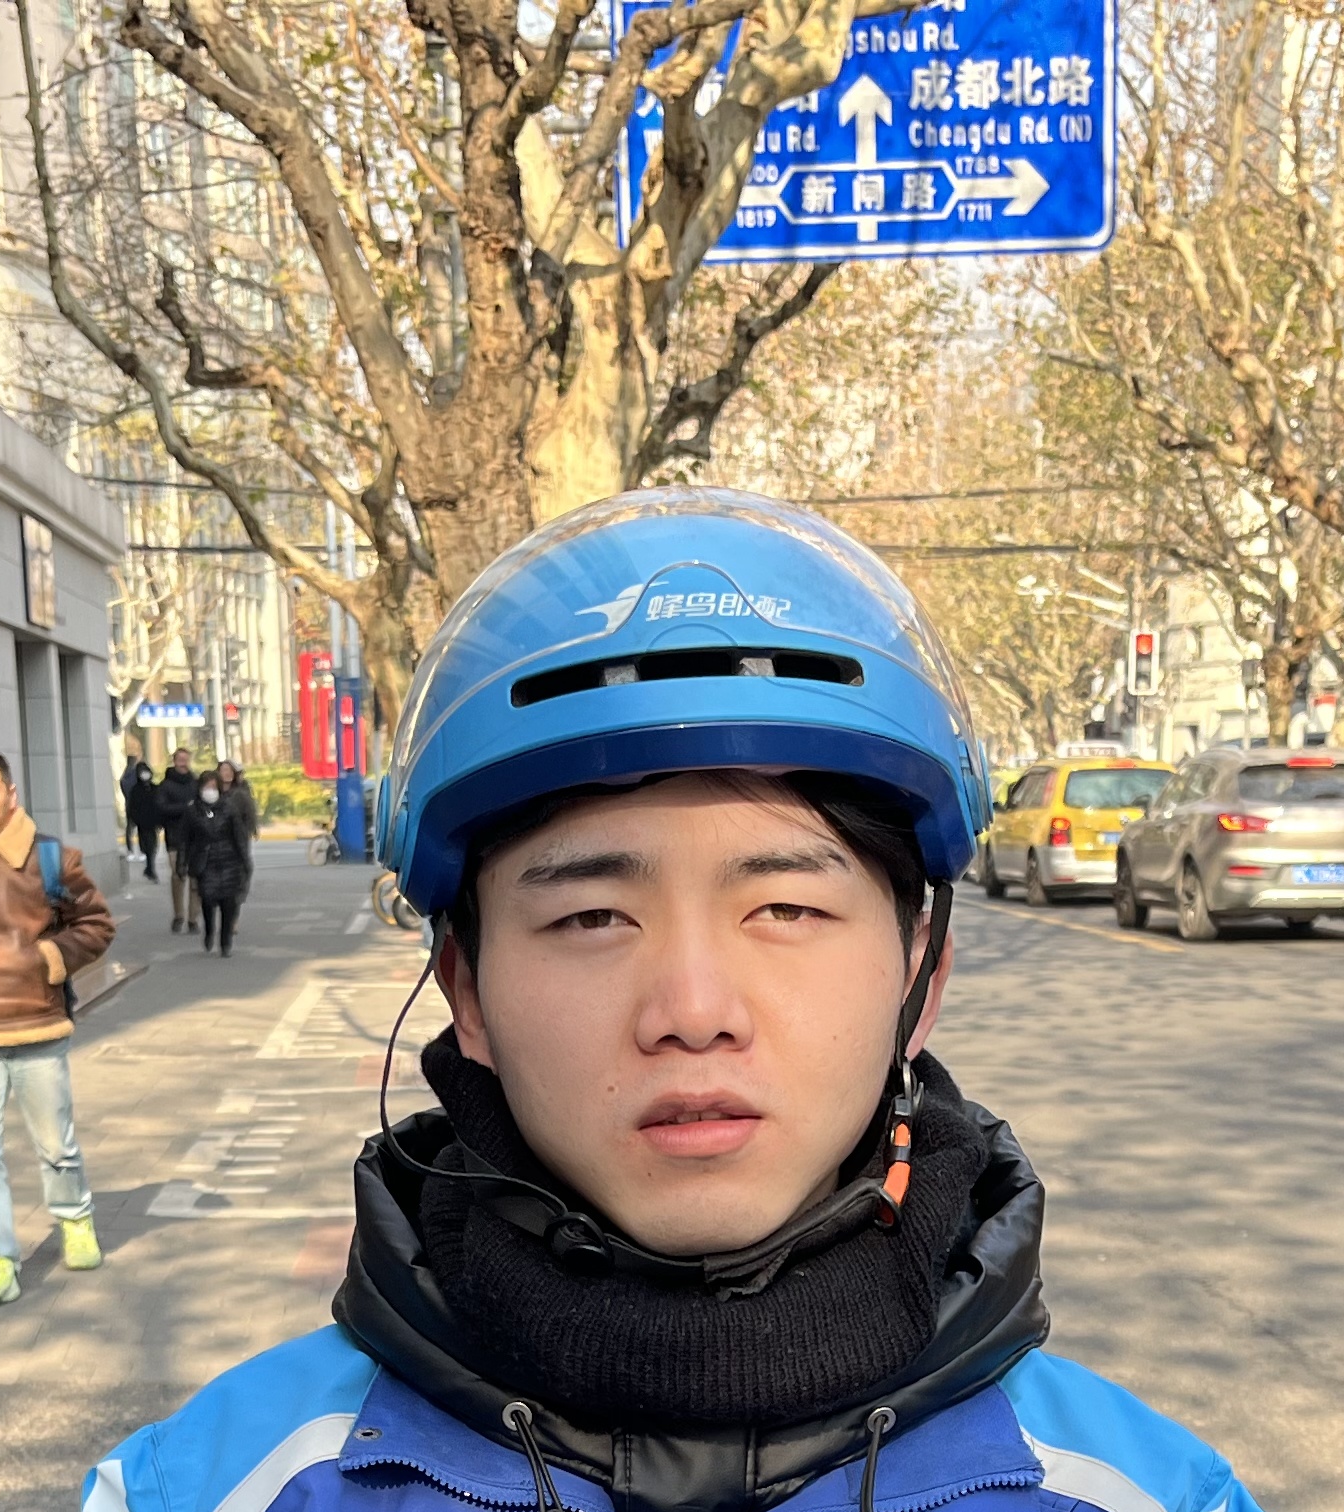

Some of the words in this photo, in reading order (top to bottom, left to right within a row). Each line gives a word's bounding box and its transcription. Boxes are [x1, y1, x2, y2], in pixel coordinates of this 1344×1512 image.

[922, 22, 960, 52] Rd.
[908, 55, 1094, 110] 成都北路
[786, 124, 821, 152] Rd.
[908, 118, 1012, 154] Chengdu
[1019, 115, 1054, 144] Rd.
[1059, 114, 1093, 143] (N)
[801, 173, 937, 213] 新闸路
[957, 203, 993, 222] 1711
[645, 592, 792, 622] 蜂鸟即配
